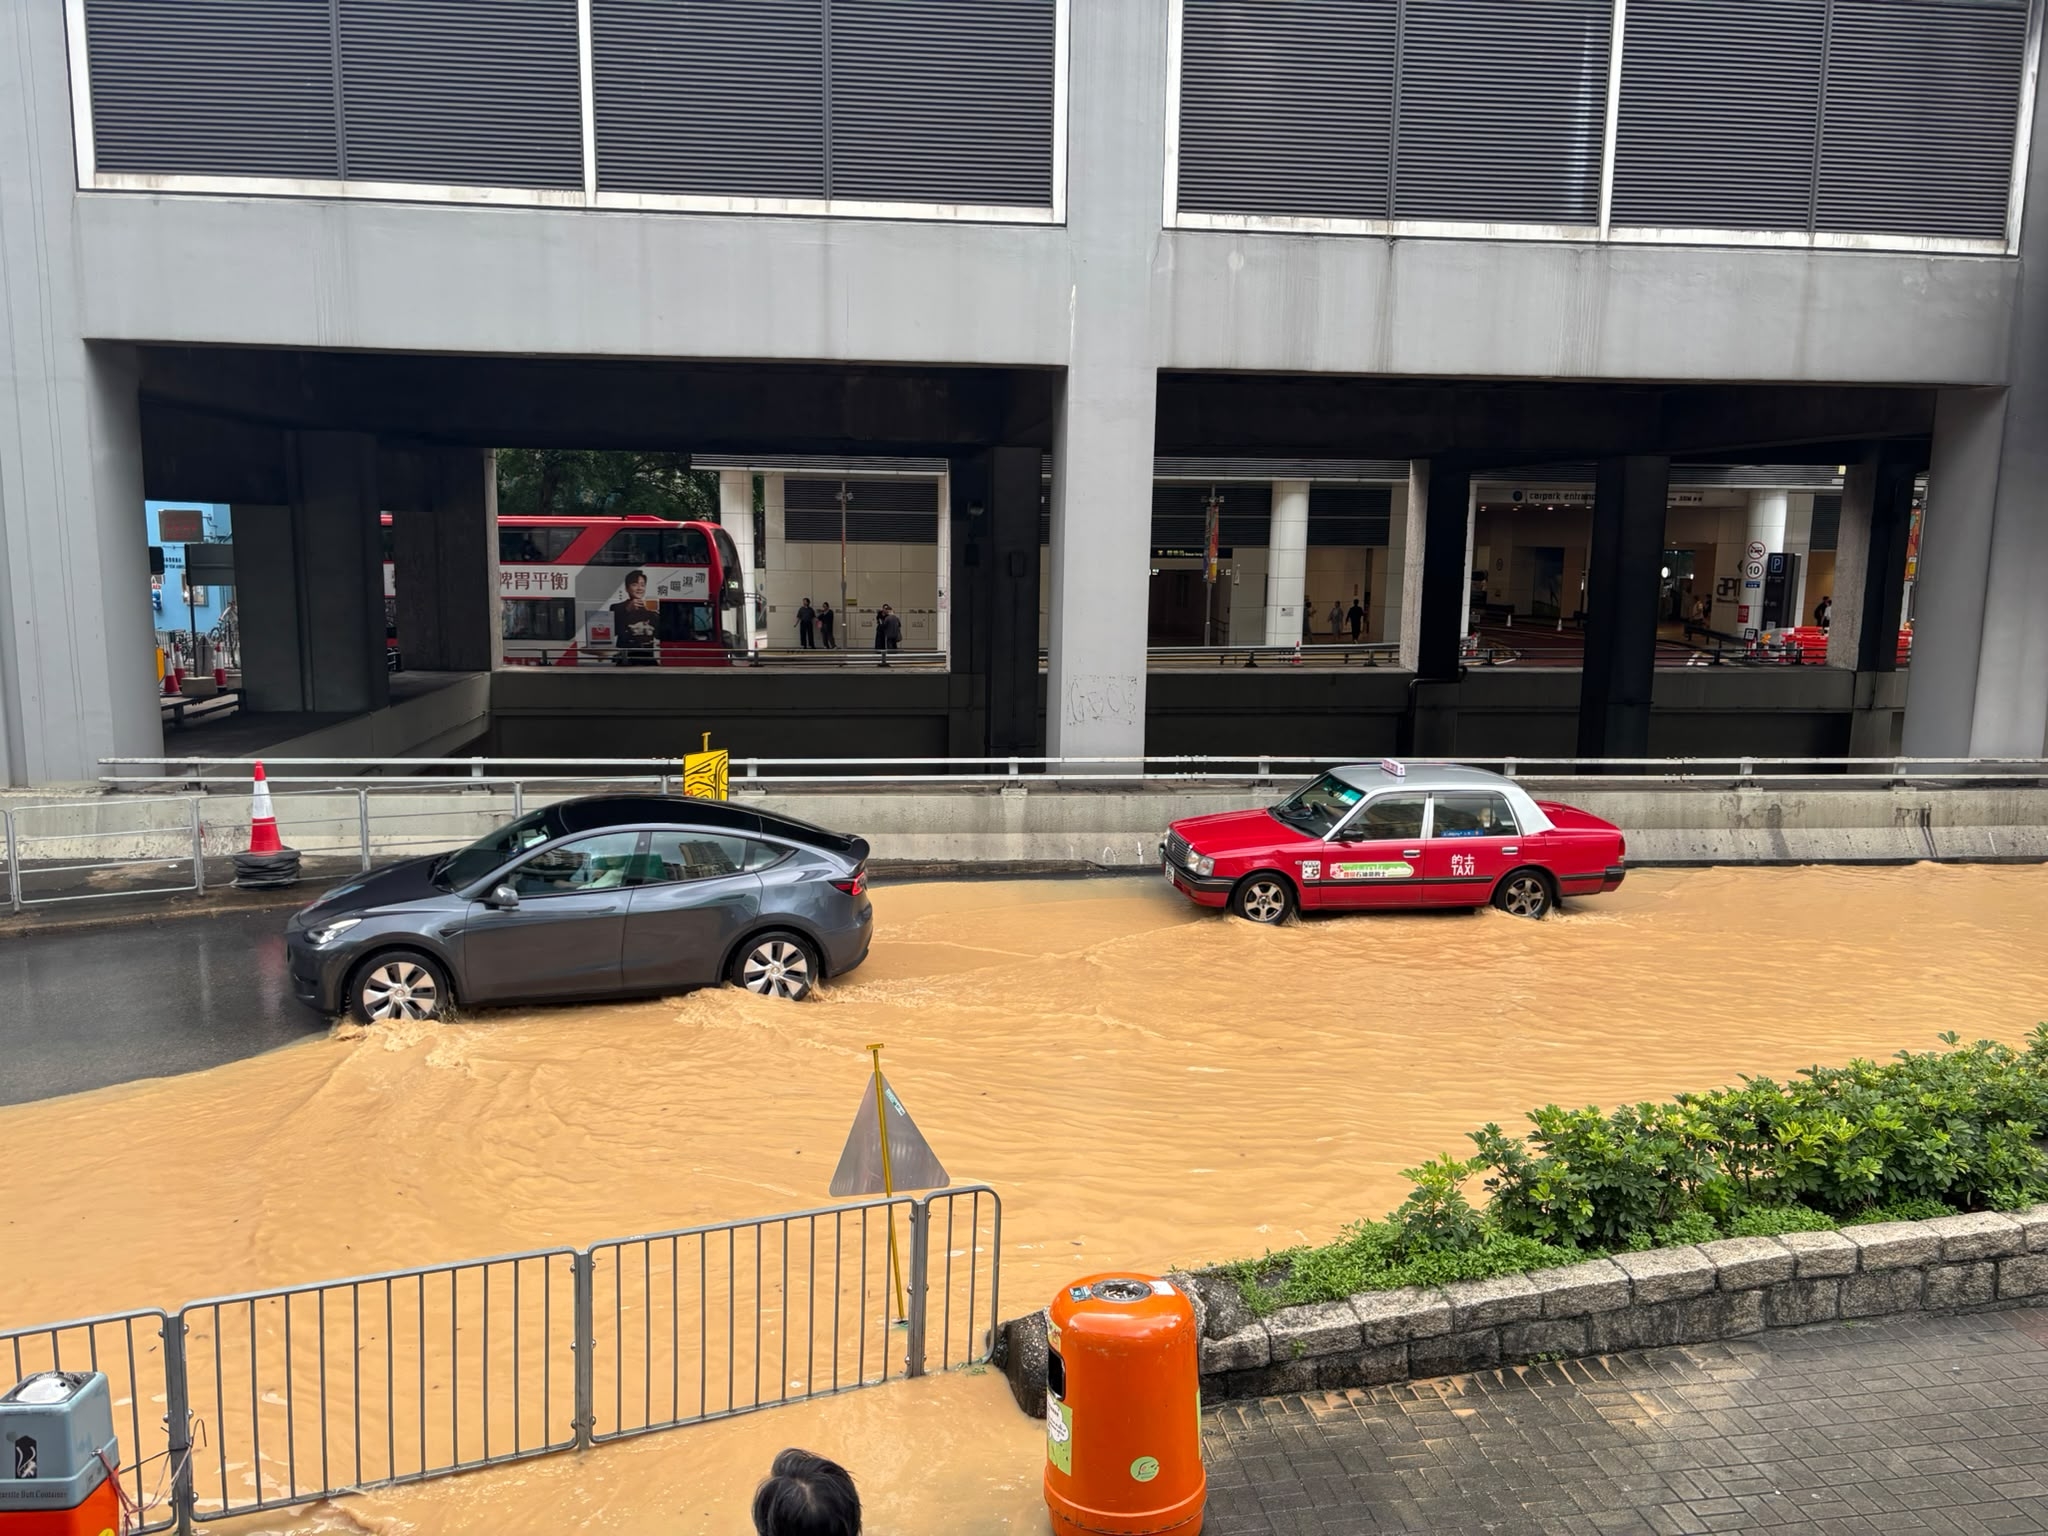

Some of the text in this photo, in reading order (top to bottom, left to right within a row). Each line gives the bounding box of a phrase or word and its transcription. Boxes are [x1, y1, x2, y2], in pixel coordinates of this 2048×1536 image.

[1529, 492, 1561, 501] carpark
[1748, 566, 1760, 575] 10
[500, 571, 569, 591] 脾胃平衡
[1451, 854, 1475, 865] 的士
[1451, 864, 1475, 876] TAXI
